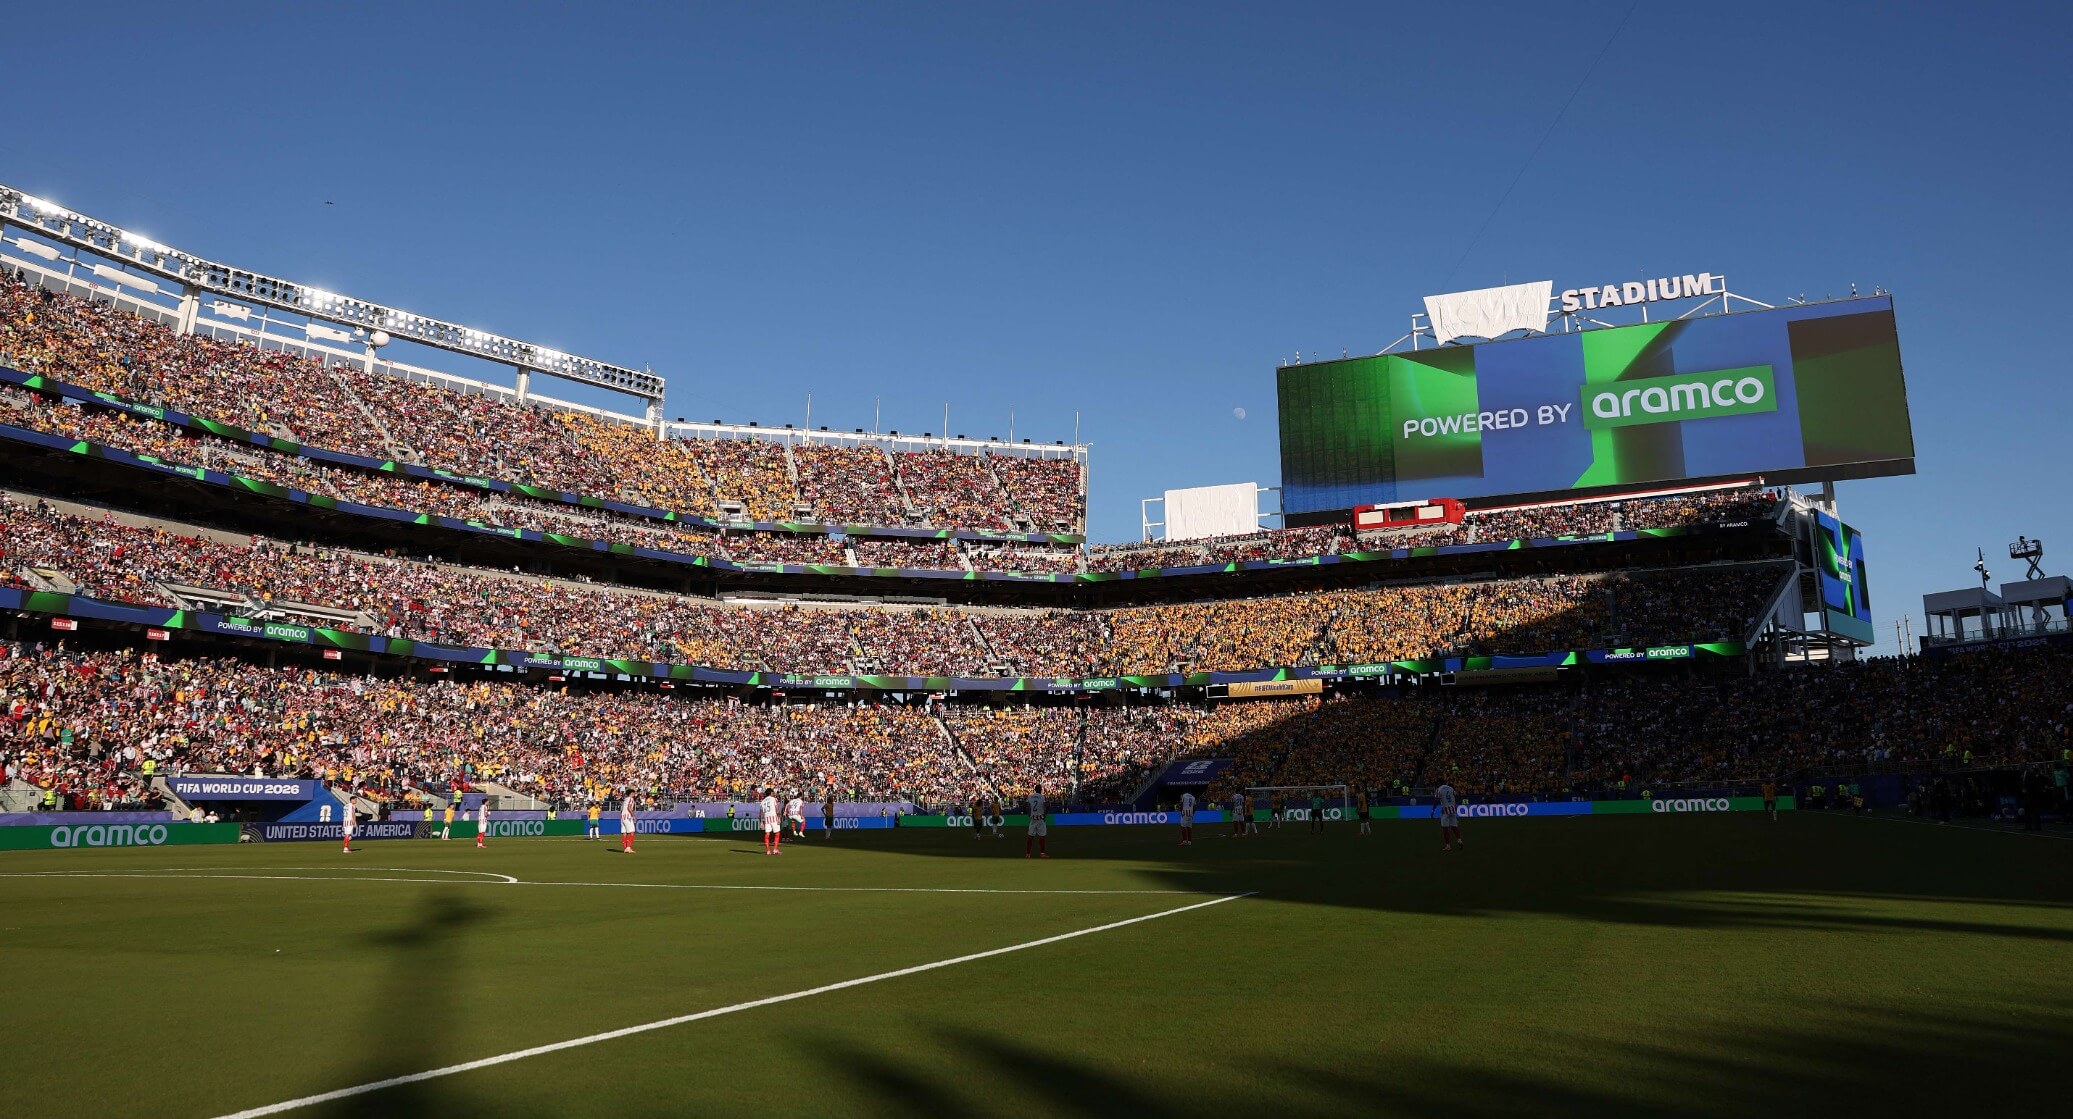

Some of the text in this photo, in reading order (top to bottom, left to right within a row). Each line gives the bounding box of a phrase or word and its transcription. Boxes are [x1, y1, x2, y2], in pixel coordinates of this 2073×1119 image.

[1561, 272, 1713, 312] STADIUM
[134, 403, 160, 416] aramco
[1404, 376, 1765, 439] POWERED BY aramco
[175, 465, 197, 475] aramco
[217, 621, 307, 639] POWERED BY aramco
[1604, 651, 1635, 660] POWERED
[1648, 647, 1688, 657] aramco
[523, 657, 552, 665] POWERED
[564, 659, 599, 669] aramco
[1310, 669, 1338, 677] POWERED
[1350, 664, 1385, 675] aramco
[815, 678, 850, 686] aramco
[1083, 679, 1115, 688] aramco
[176, 783, 300, 795] FIFA WORLD CUP 2026
[1456, 803, 1529, 817] aramco
[1652, 797, 1730, 813] aramco
[1104, 812, 1168, 825] aramco
[265, 824, 307, 839] UNITED
[352, 824, 365, 838] OF
[365, 823, 412, 837] AMERICA
[635, 819, 671, 834] amco
[50, 824, 168, 848] aramco
